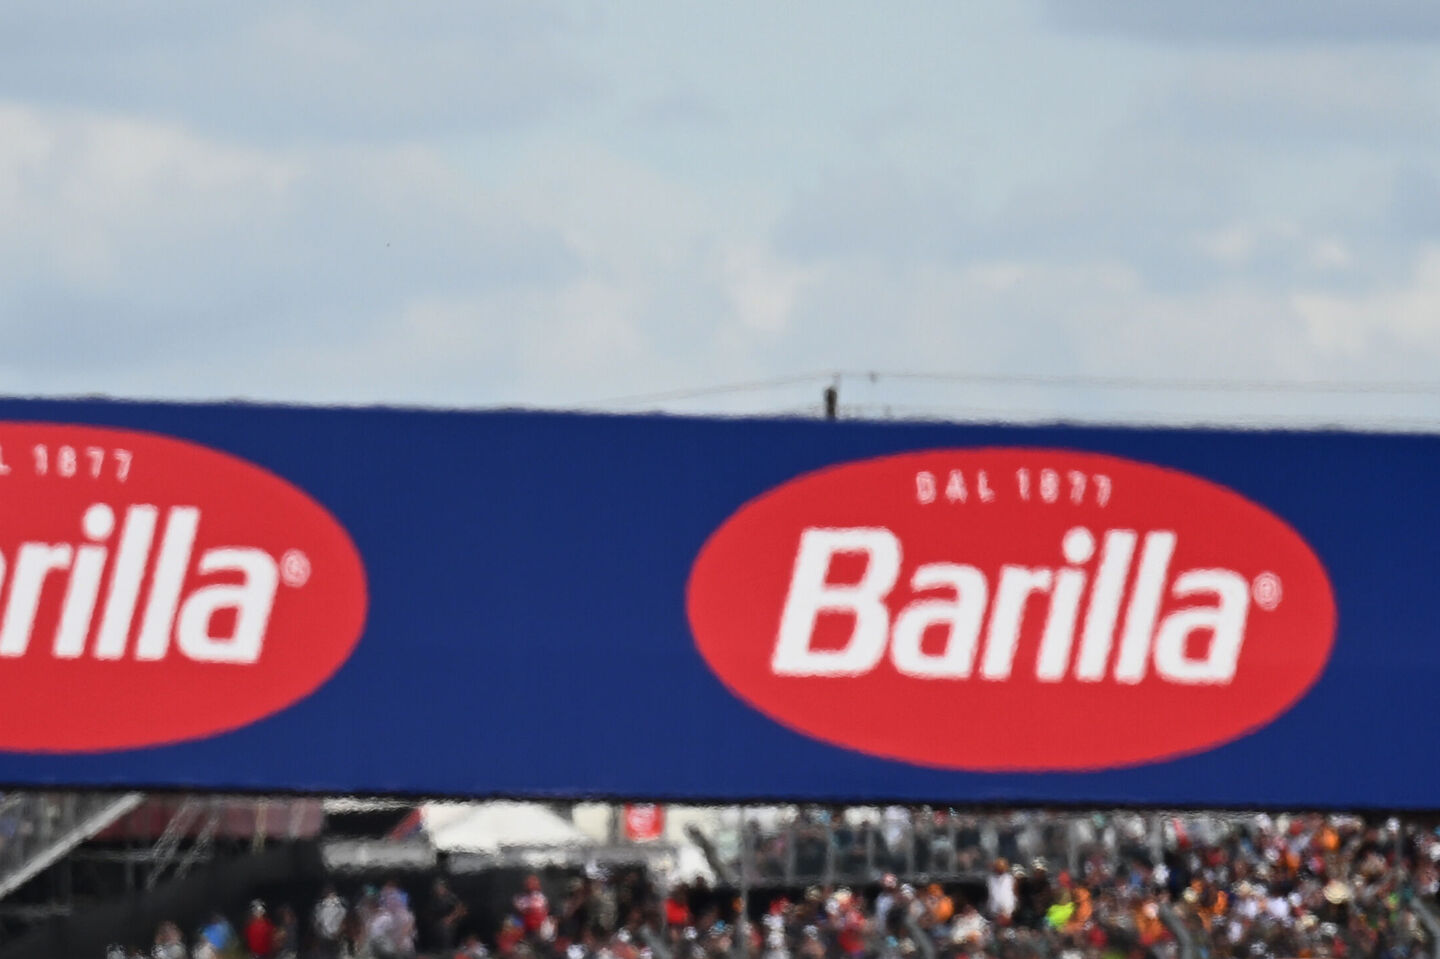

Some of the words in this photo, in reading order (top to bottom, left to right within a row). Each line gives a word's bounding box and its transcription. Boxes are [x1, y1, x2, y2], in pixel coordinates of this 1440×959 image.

[33, 444, 133, 482] 1877
[915, 469, 995, 504] DAL
[1017, 468, 1112, 507] 1877
